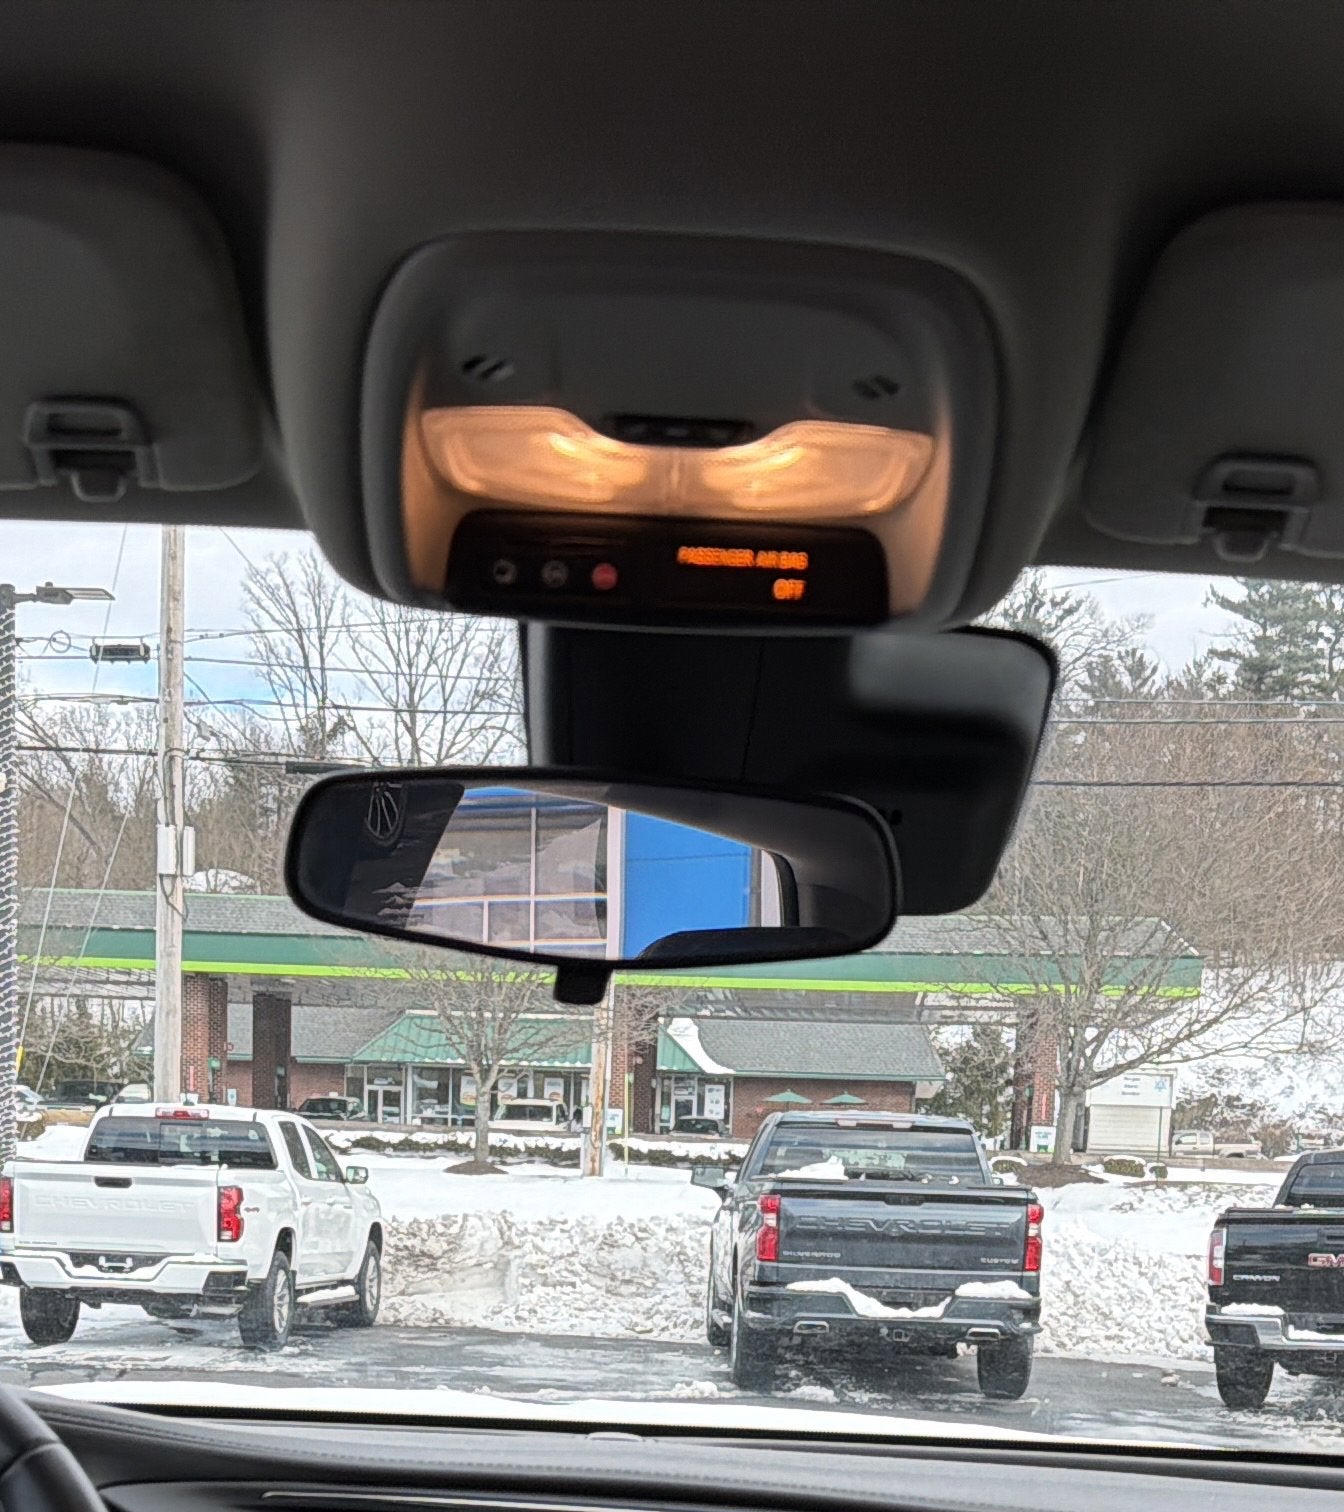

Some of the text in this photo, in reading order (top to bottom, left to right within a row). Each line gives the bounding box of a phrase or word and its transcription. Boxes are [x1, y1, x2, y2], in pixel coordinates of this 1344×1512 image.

[773, 578, 806, 600] OFF
[33, 1194, 195, 1213] CHEVROLET
[796, 1215, 1012, 1237] CHEVROLET
